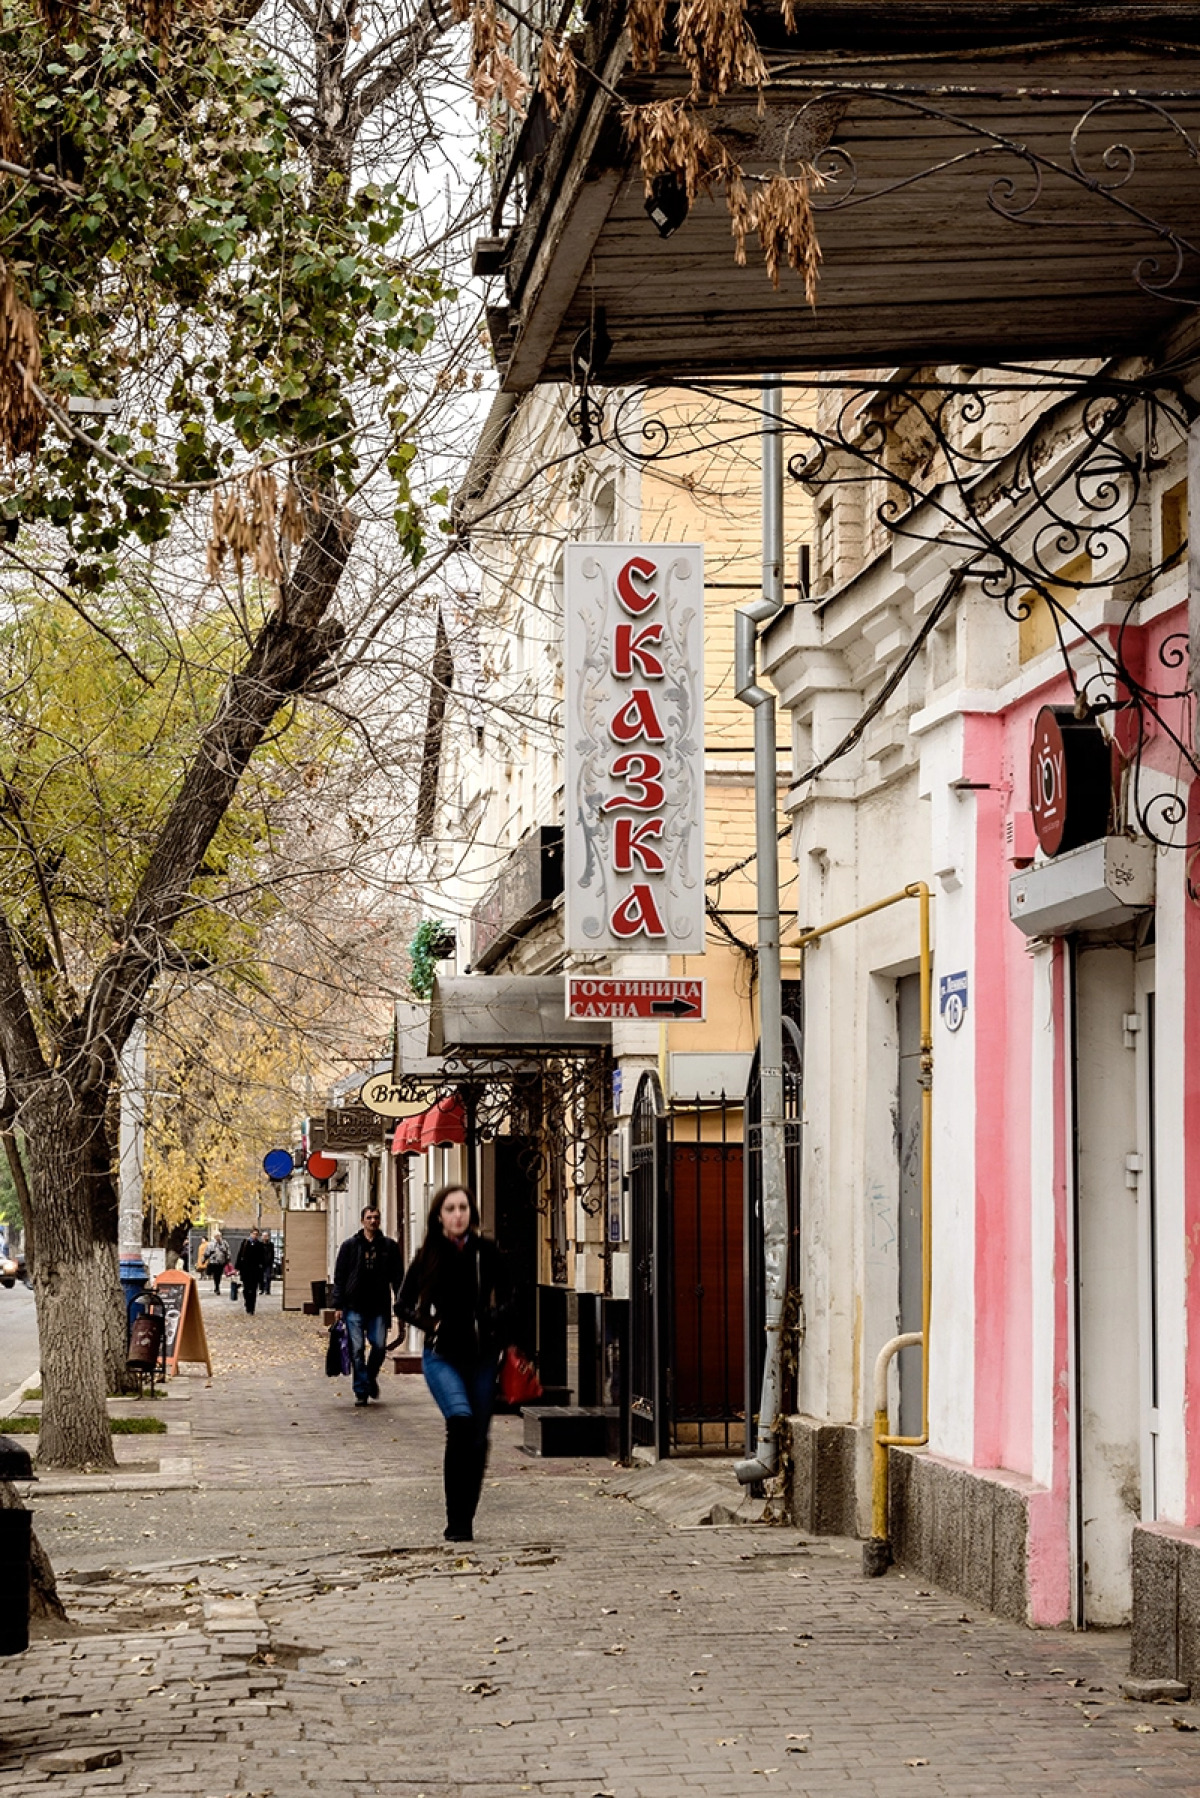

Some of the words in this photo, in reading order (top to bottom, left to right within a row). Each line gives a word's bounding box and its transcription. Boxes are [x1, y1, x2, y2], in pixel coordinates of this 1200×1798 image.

[603, 555, 664, 939] СКАЗКА
[570, 981, 701, 998] ГОСТИНИЦА
[570, 1001, 639, 1017] САУНА
